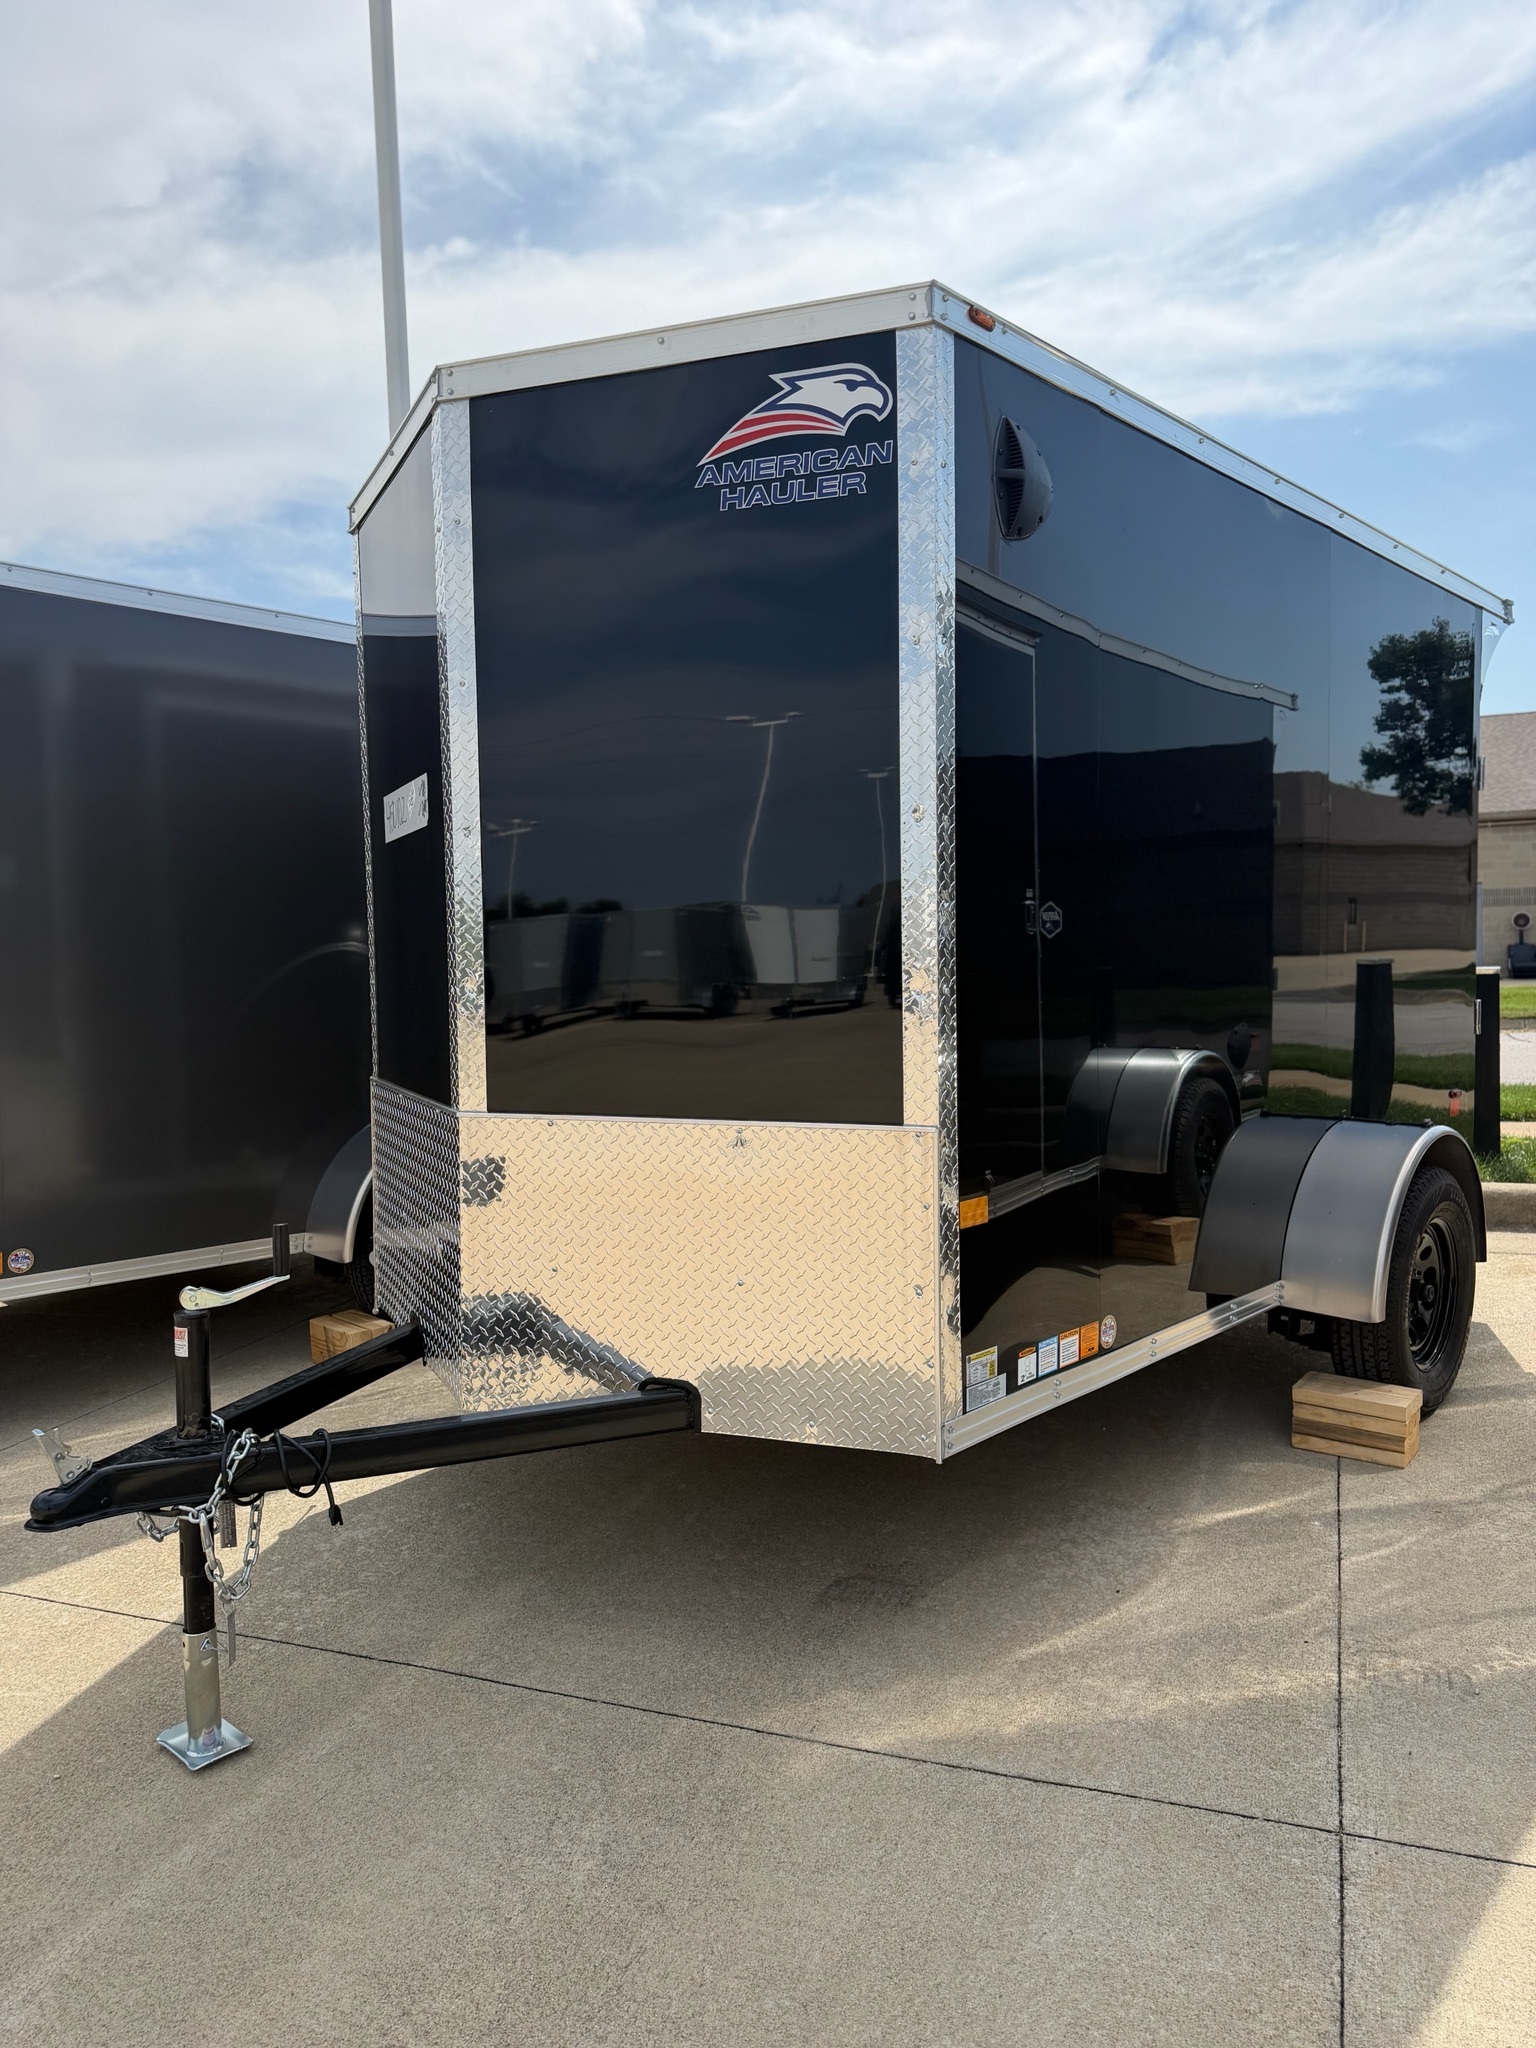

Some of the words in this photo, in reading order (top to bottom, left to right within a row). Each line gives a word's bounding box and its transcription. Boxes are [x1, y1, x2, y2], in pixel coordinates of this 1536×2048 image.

[694, 440, 894, 489] AMERICAN
[719, 471, 867, 512] HAULER
[1039, 1337, 1058, 1349] NOTICE
[1060, 1328, 1079, 1340] CAUTION
